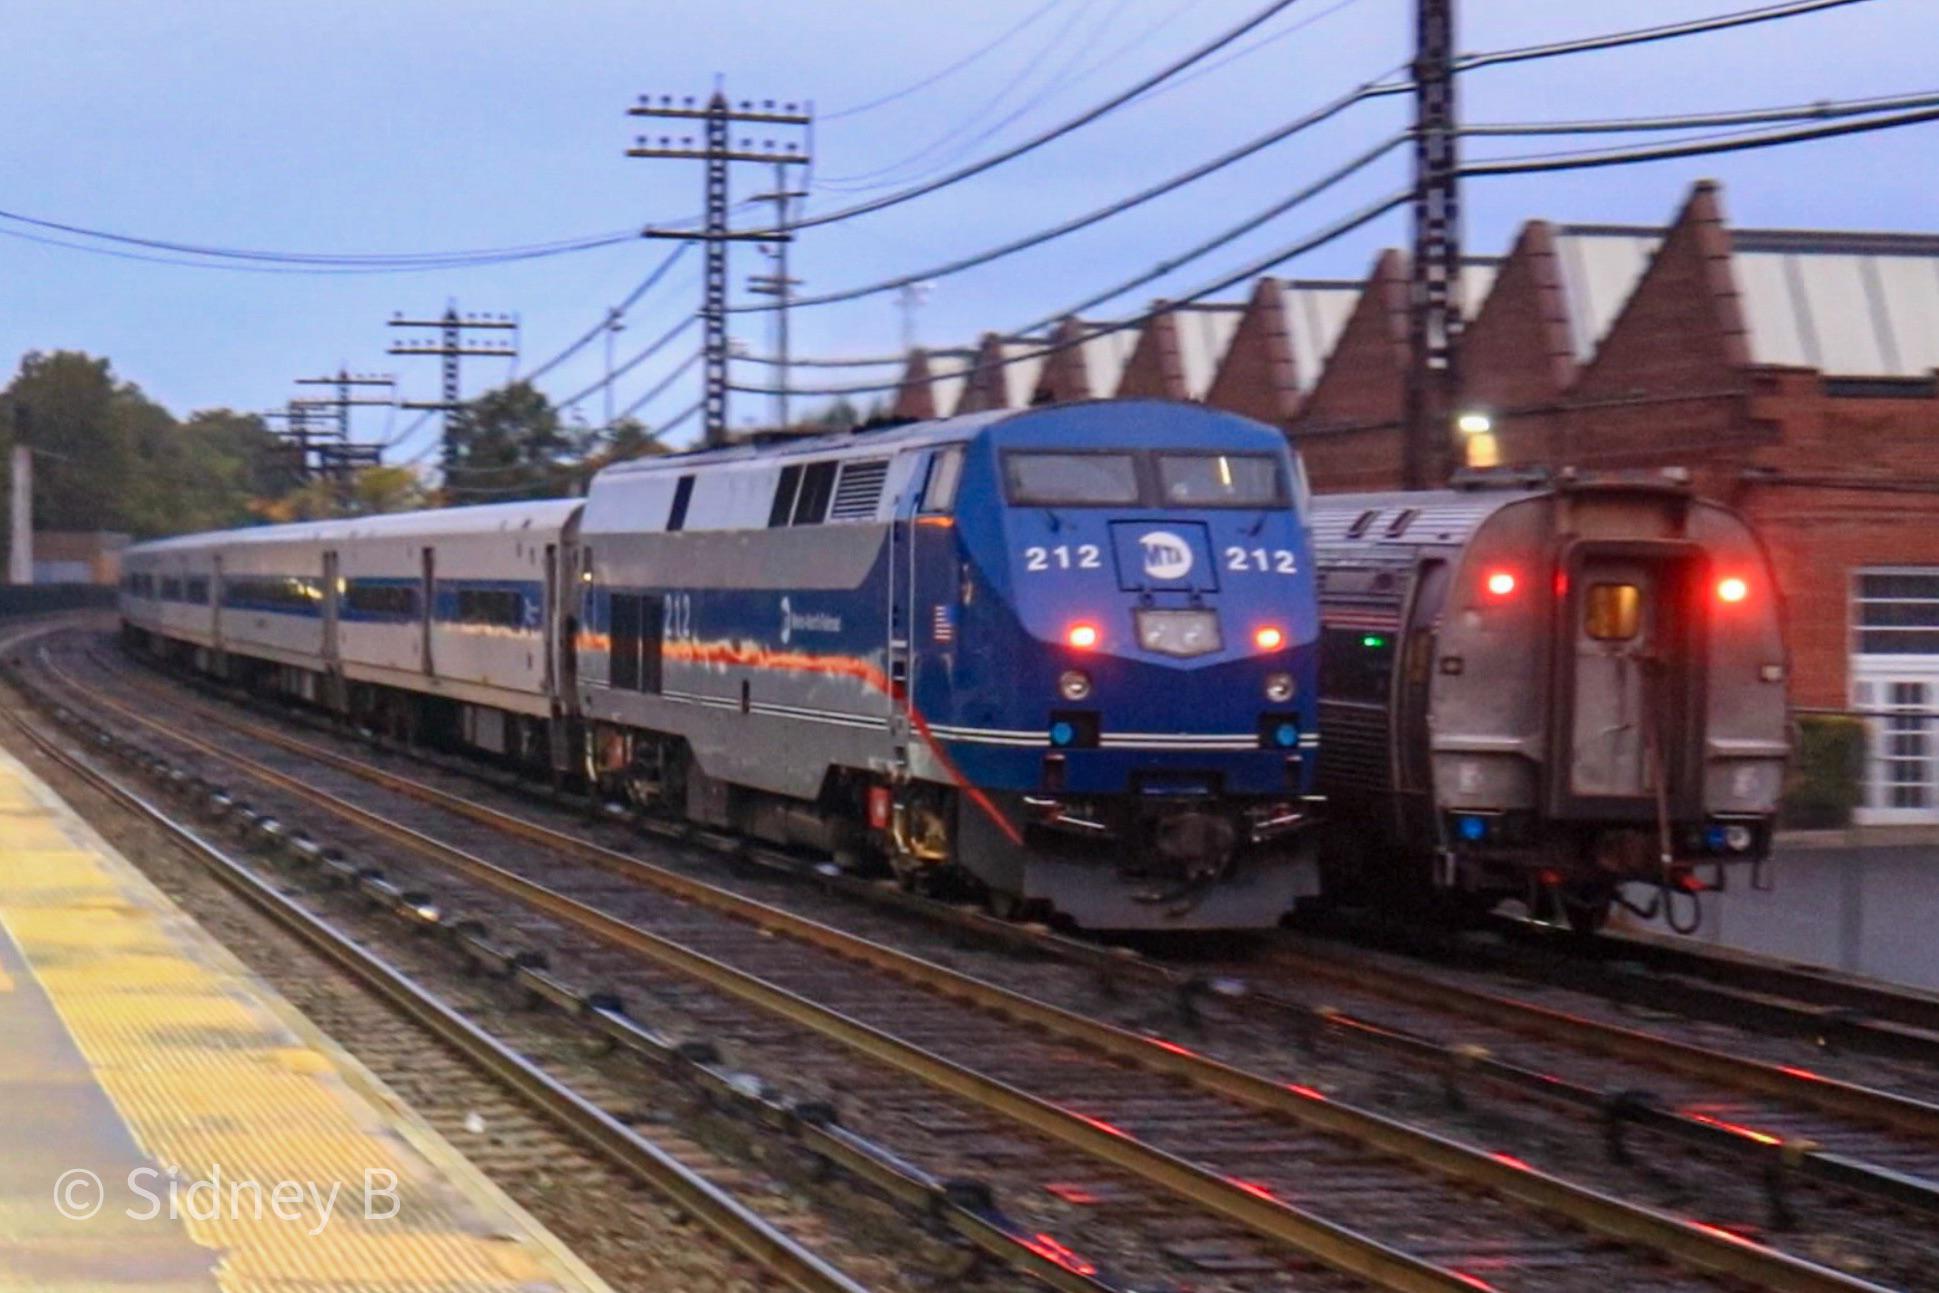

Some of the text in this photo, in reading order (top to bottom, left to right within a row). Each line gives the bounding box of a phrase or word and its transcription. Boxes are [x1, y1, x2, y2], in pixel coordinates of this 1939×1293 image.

[1025, 544, 1101, 571] 212
[1225, 547, 1297, 574] 212
[664, 593, 691, 637] 212
